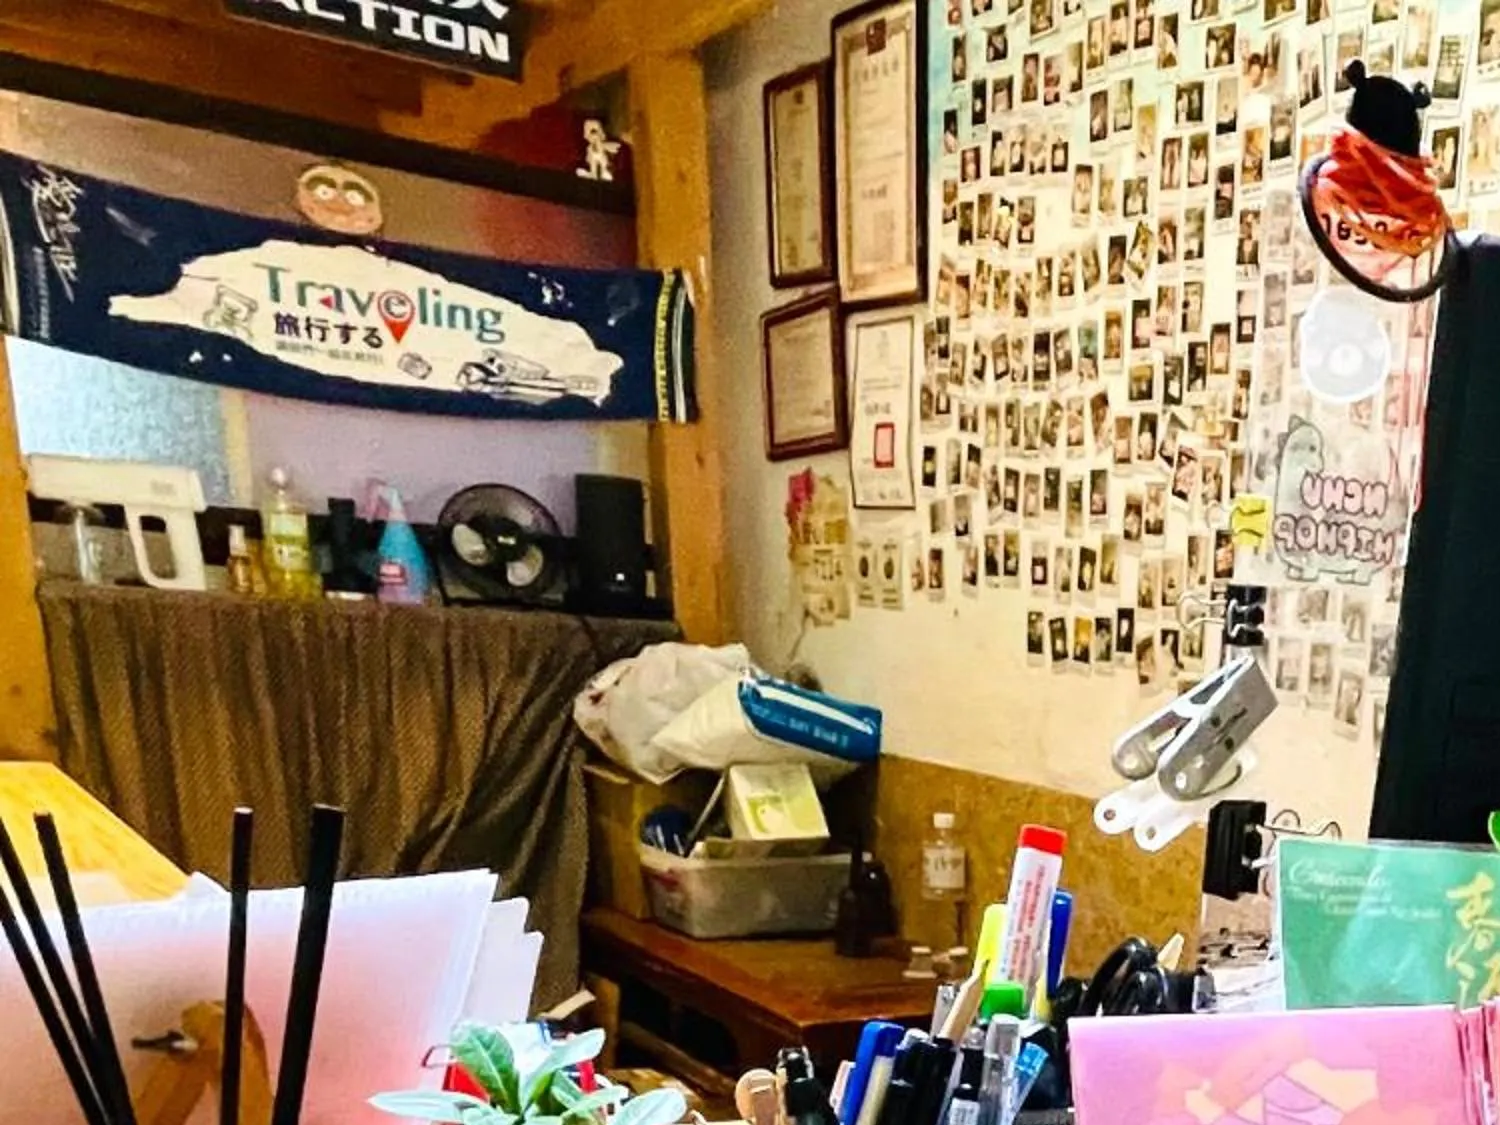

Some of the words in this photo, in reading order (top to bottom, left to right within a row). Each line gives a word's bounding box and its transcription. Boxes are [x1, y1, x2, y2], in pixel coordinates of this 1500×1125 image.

[254, 262, 505, 344] Traveling
[274, 311, 384, 349] 旅行する
